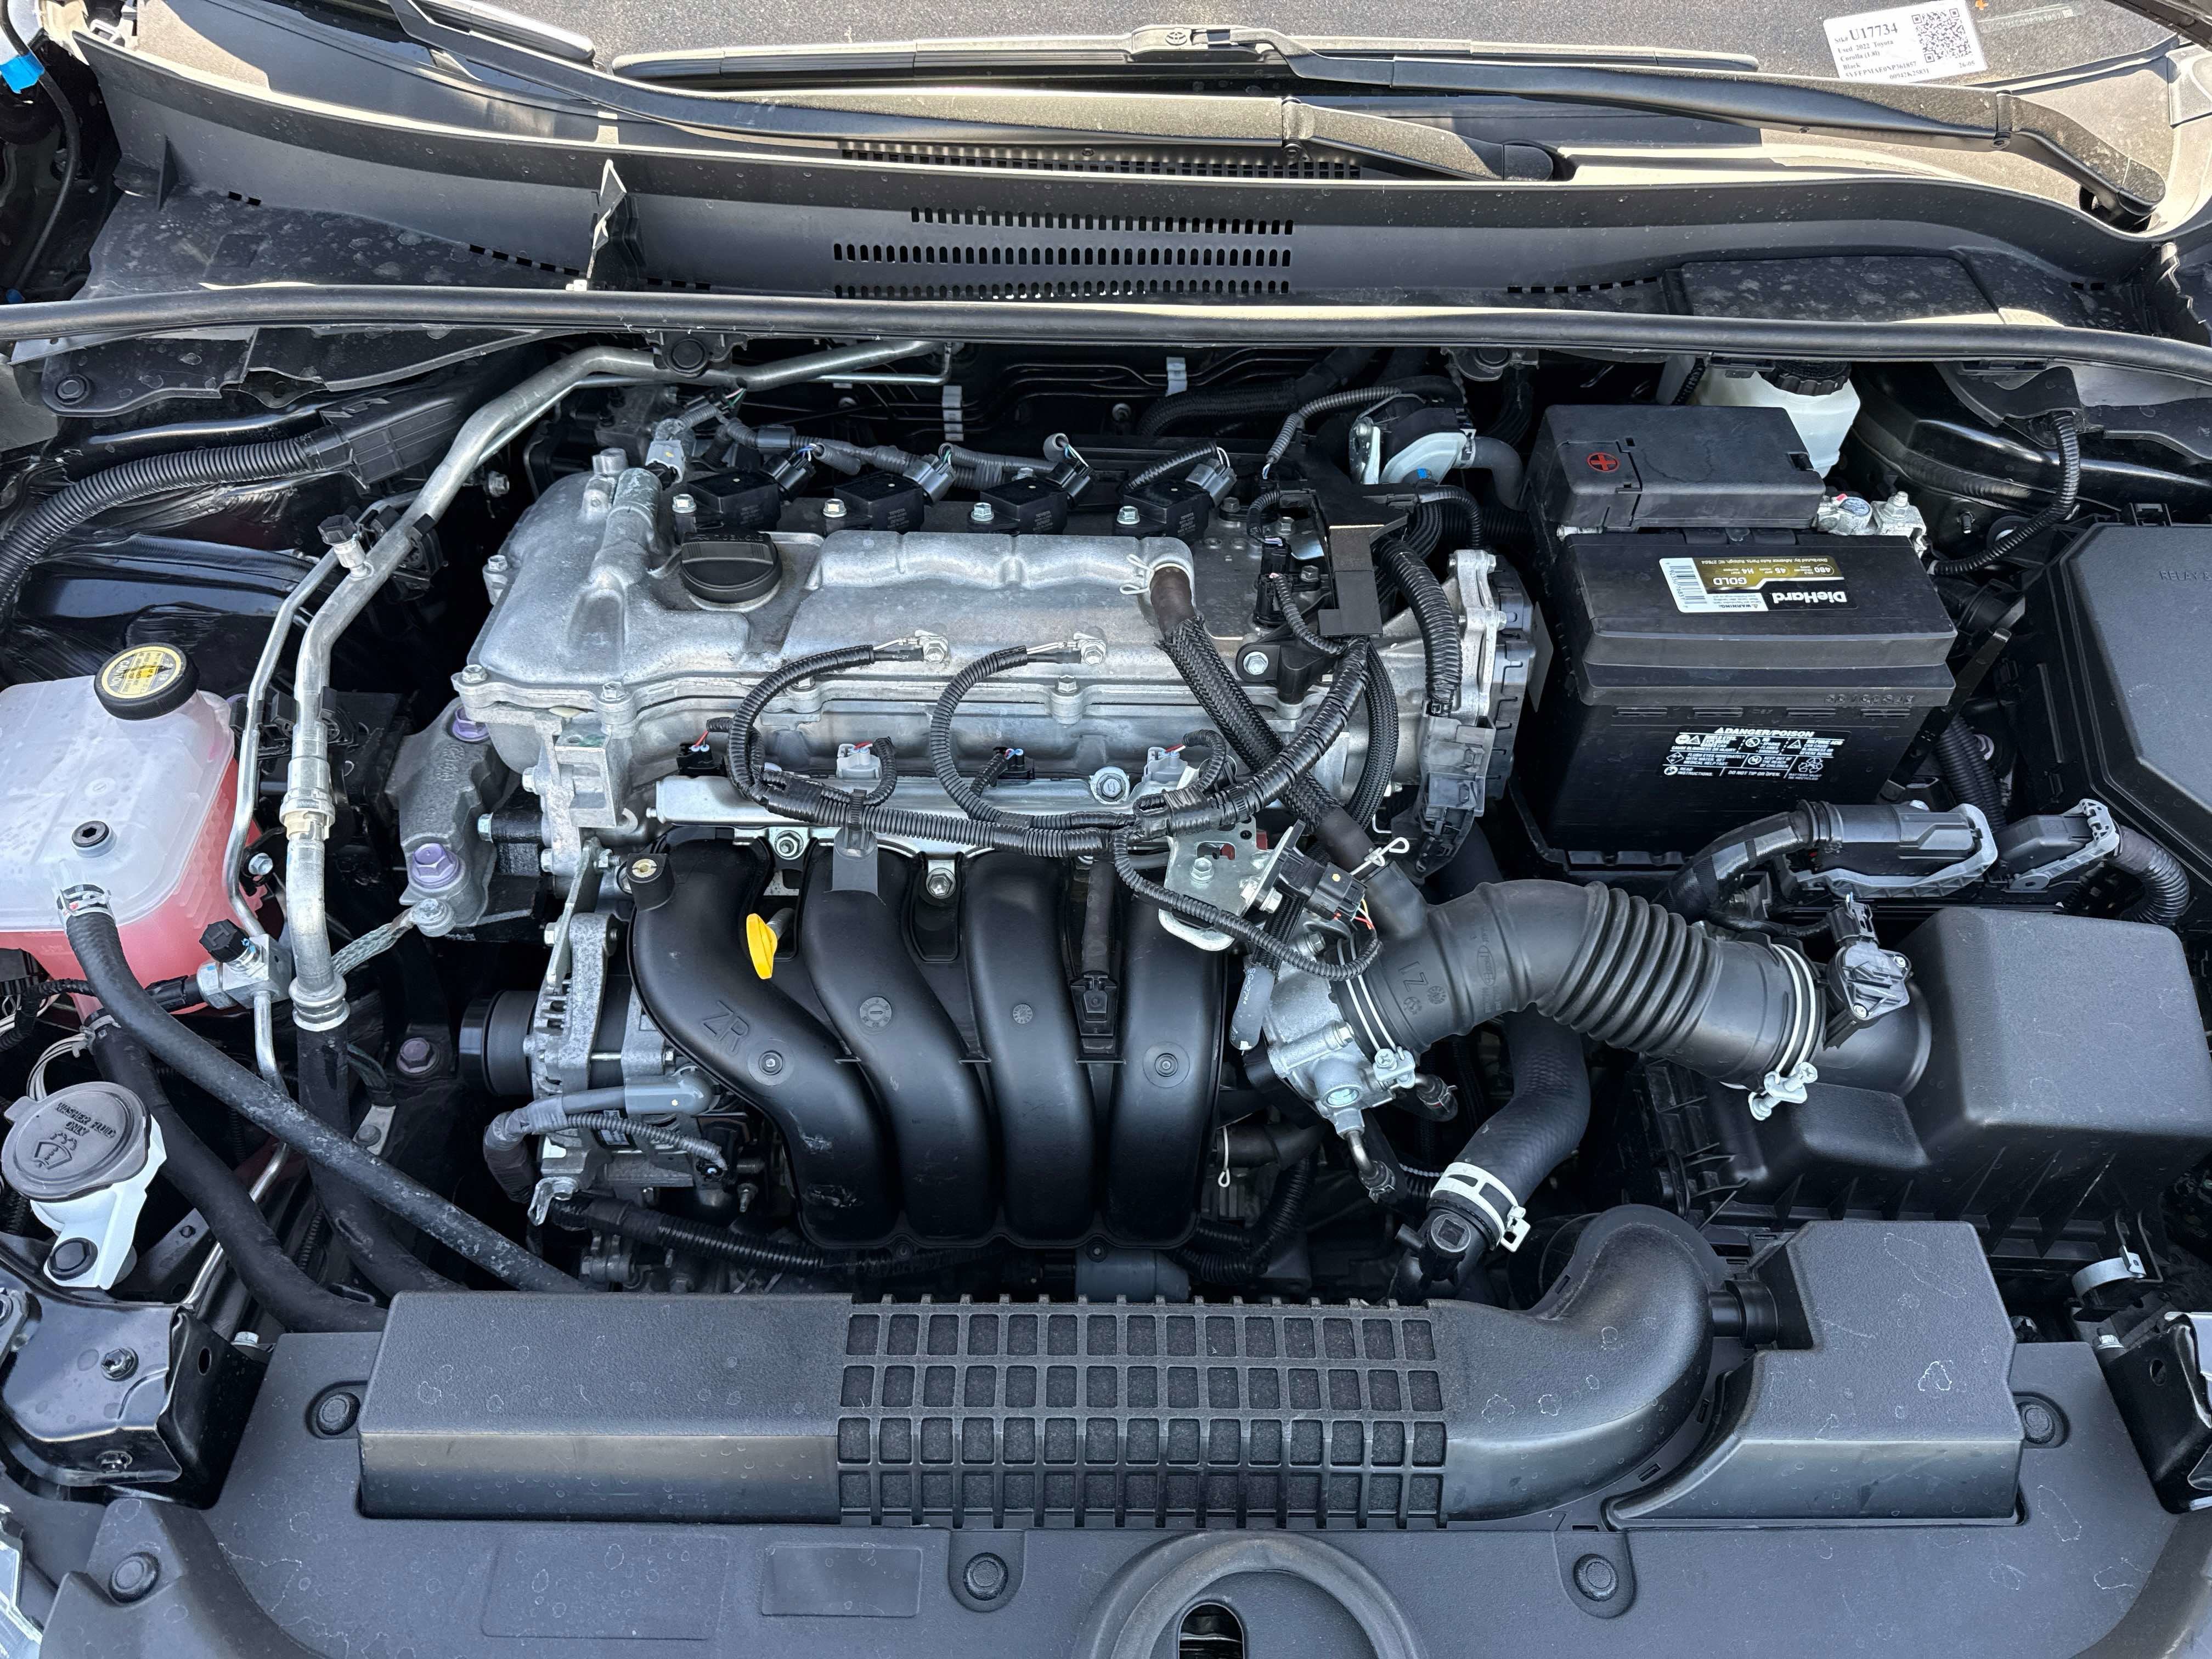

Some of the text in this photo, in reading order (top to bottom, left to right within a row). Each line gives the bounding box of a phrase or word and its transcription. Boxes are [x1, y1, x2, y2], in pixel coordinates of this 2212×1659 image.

[1849, 22, 1898, 40] U17734
[1713, 577, 1747, 585] GOLD
[2159, 571, 2198, 580] RELAY
[1771, 591, 1847, 603] DieHard
[110, 660, 129, 686] CAUTION
[1724, 727, 1815, 737] DANGER/POISON
[702, 1000, 750, 1056] ZR
[57, 1102, 116, 1138] WASHER FLUID
[65, 1121, 90, 1136] ONLY
